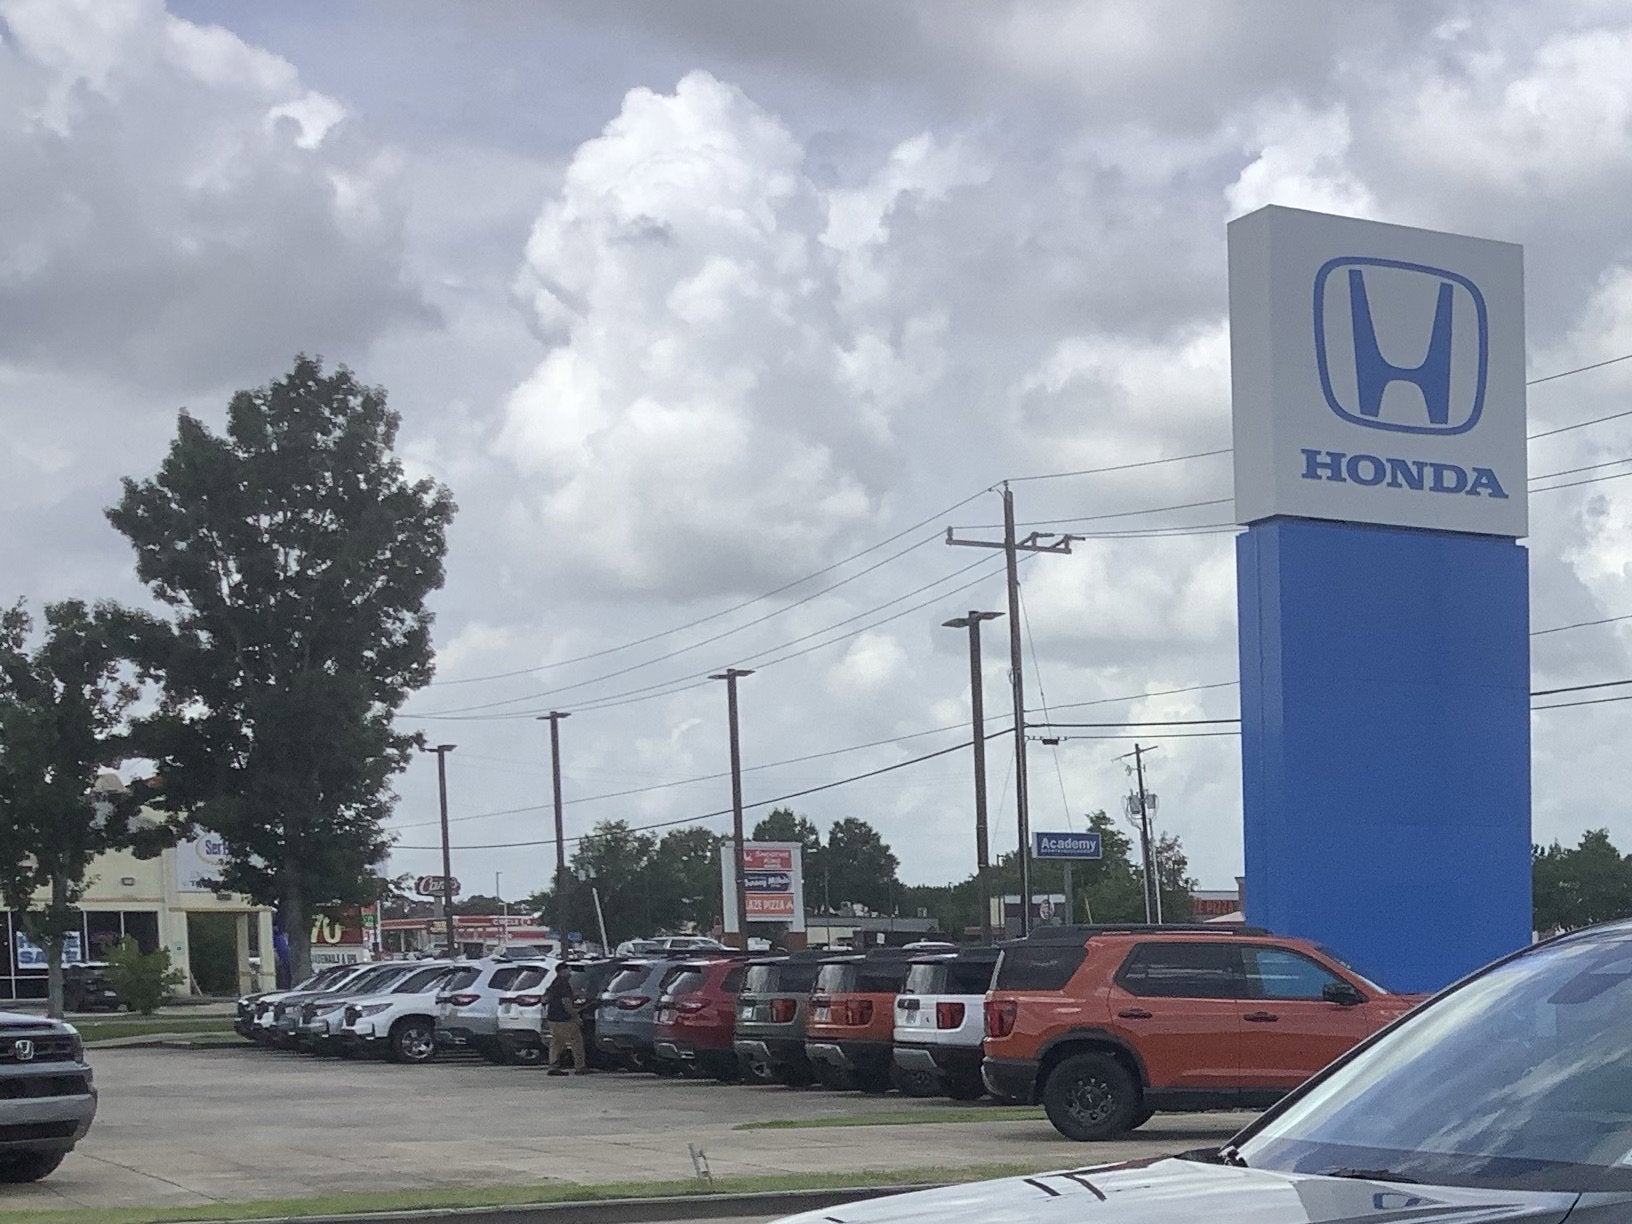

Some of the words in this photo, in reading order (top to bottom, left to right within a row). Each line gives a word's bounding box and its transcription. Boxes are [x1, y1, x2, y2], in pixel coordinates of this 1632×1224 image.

[1301, 448, 1509, 499] HONDA
[1041, 837, 1096, 852] Academy
[764, 900, 785, 910] PIZZA
[1207, 900, 1234, 914] PIZZA
